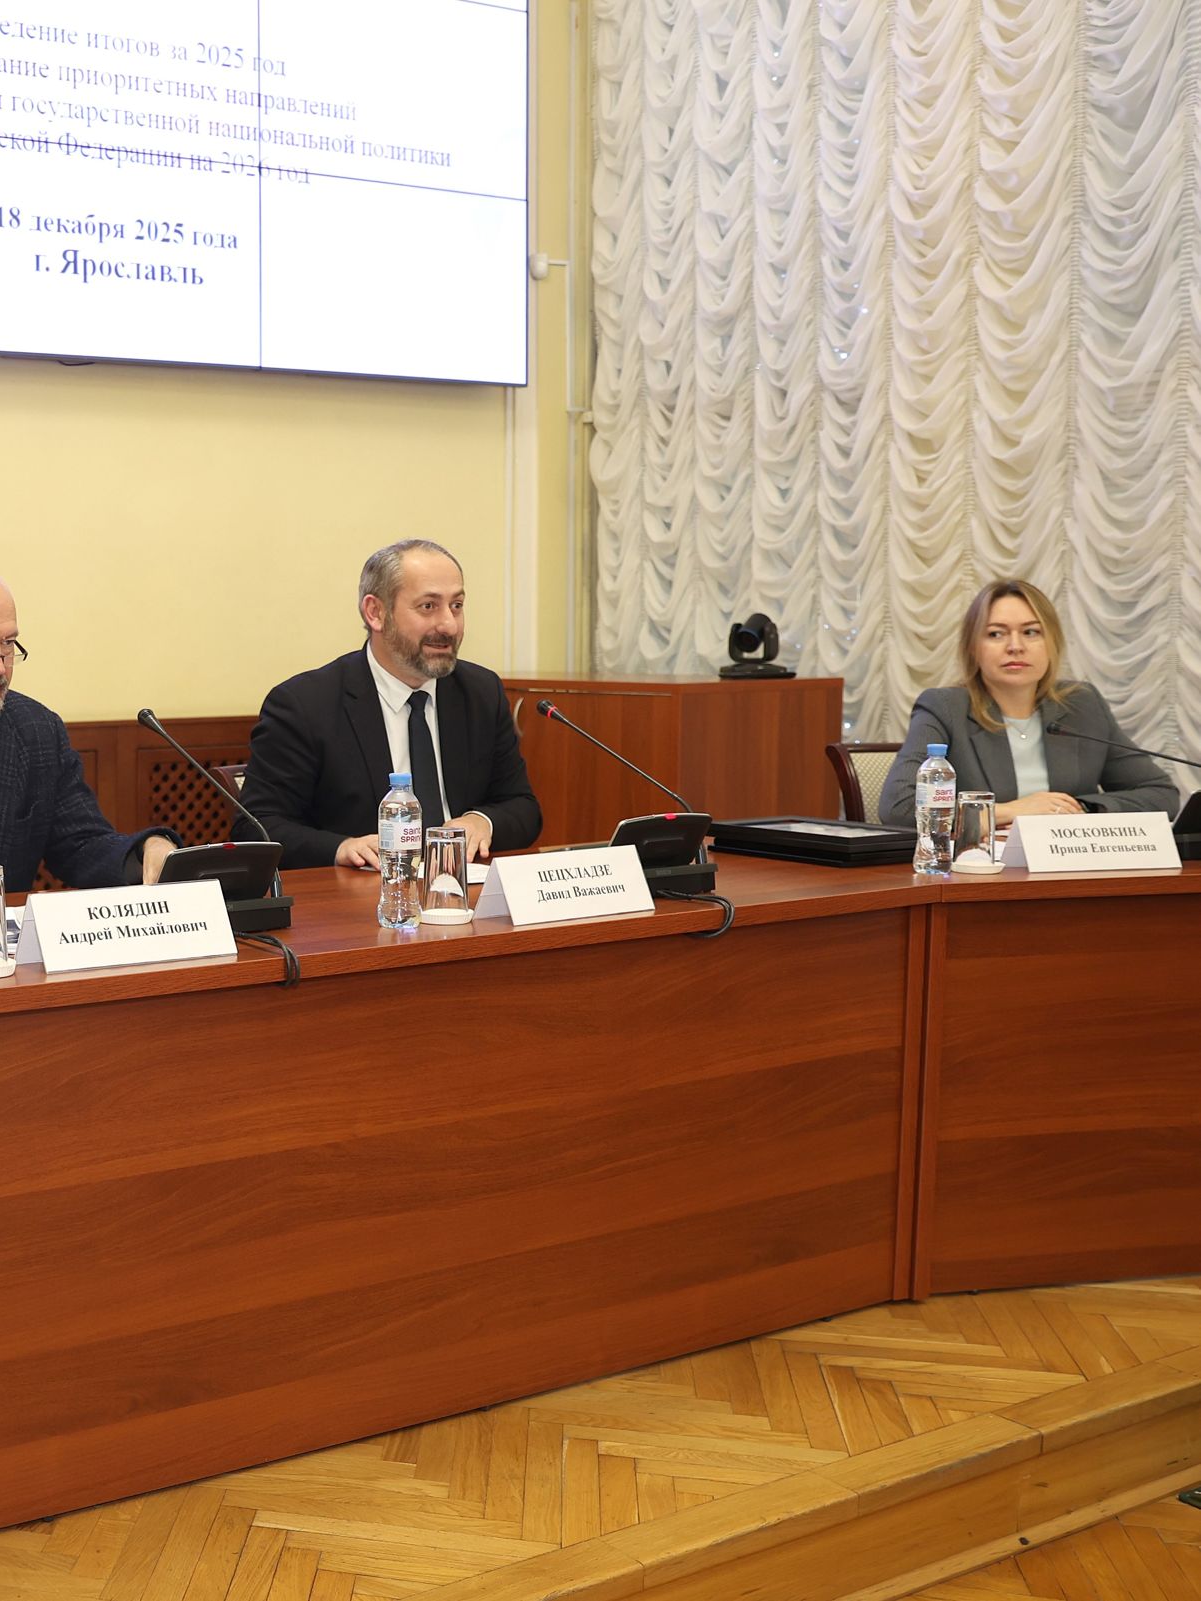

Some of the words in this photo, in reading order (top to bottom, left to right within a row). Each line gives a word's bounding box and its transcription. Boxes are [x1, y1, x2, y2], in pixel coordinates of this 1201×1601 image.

[87, 31, 160, 58] итогов
[171, 44, 188, 61] за
[196, 42, 245, 69] 2025
[252, 57, 287, 77] год
[58, 65, 218, 102] приоритетных
[225, 87, 357, 121] направлений
[11, 95, 200, 135] государственной
[208, 120, 356, 156] национальной
[361, 141, 452, 168] политики
[58, 133, 183, 169] Федерации
[189, 154, 213, 172] на
[221, 152, 271, 178] 2026
[277, 163, 310, 184] год
[29, 215, 125, 243] декабря
[134, 219, 184, 245] 2025
[192, 229, 238, 250] года
[34, 252, 50, 273] г.
[60, 249, 204, 286] Ярославль
[401, 835, 421, 843] SPRIN
[1051, 827, 1147, 839] МОСКОВКИНА
[1049, 844, 1088, 856] Ирина
[1091, 843, 1157, 853] Евгеньевна
[538, 864, 612, 883] ЦЕЦХЛАДЗЕ
[537, 889, 572, 903] Давид
[573, 885, 626, 898] Важаевич
[87, 900, 170, 920] КОЛЯДИН
[59, 927, 113, 945] Андрей
[117, 921, 208, 939] Михайлович
